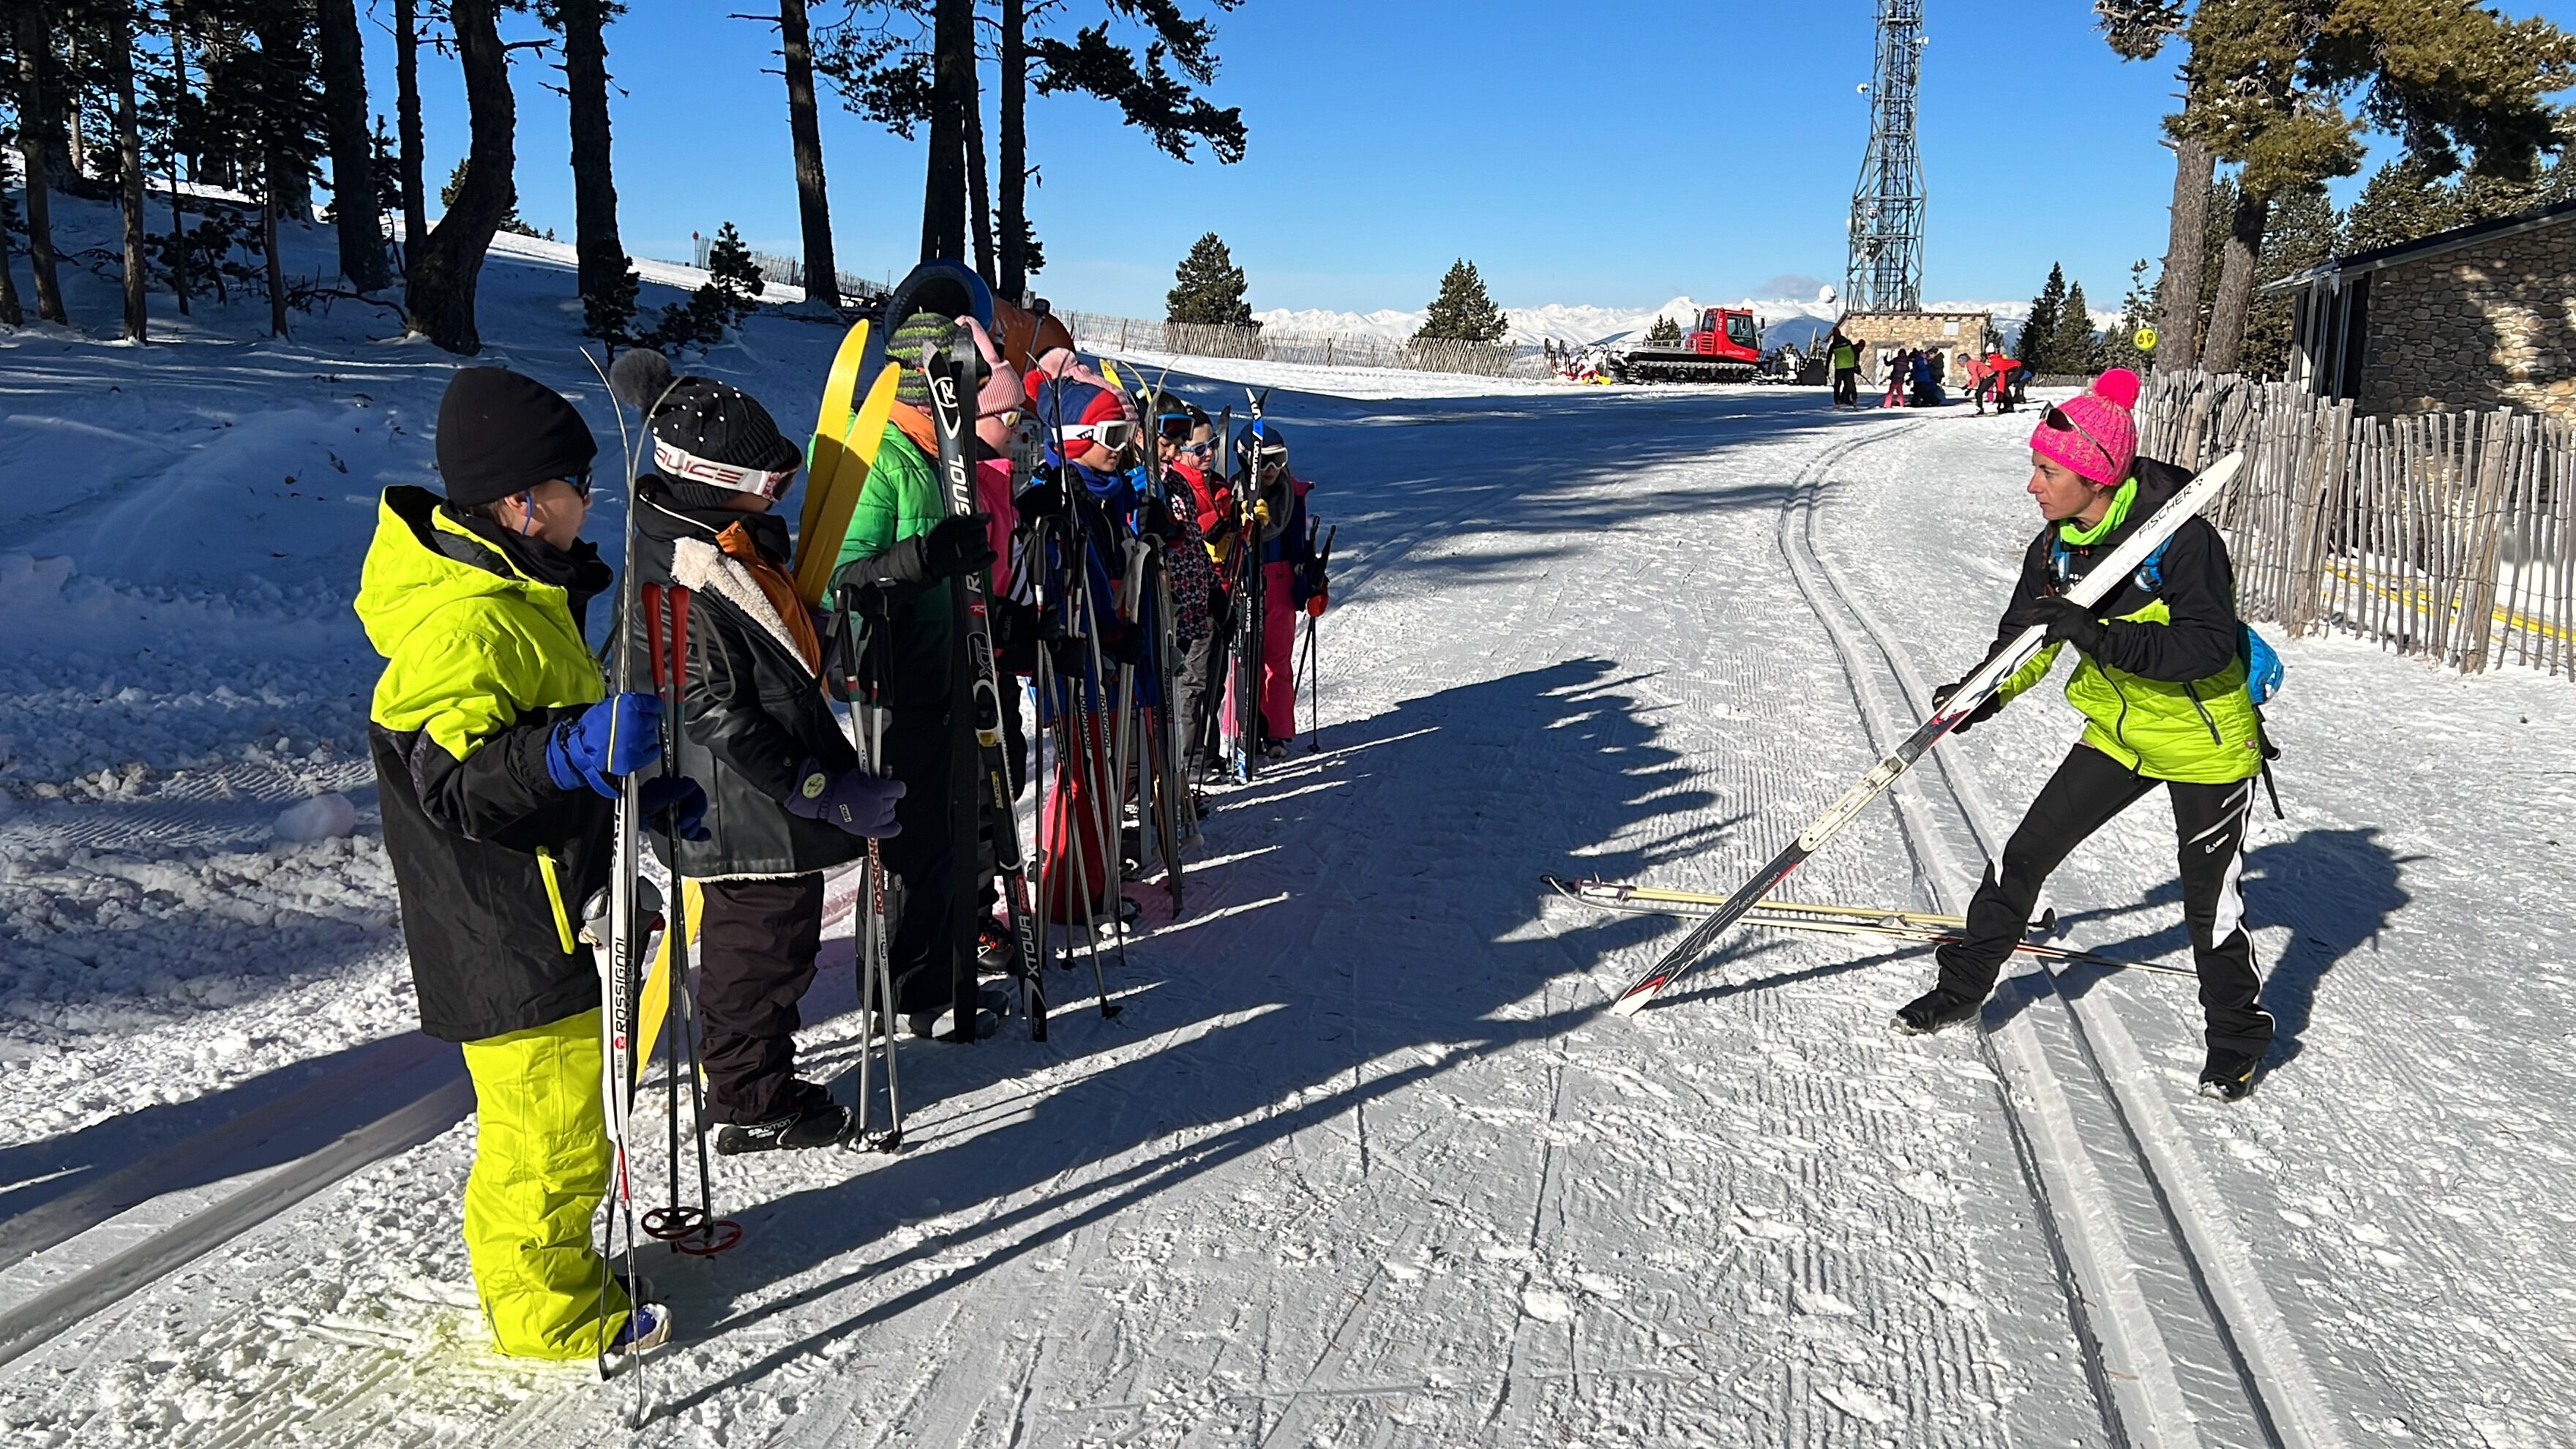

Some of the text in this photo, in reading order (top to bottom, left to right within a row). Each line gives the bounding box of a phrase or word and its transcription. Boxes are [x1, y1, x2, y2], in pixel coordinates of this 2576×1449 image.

[656, 446, 744, 484] ALICE
[1250, 441, 1259, 491] salomon
[2138, 485, 2193, 539] FISCHER
[1079, 694, 1093, 750] ROSSIGNOL
[1099, 694, 1111, 749] ROSSIGNOL
[615, 937, 626, 1033] ROSSIGNOL
[747, 1118, 791, 1137] salomon
